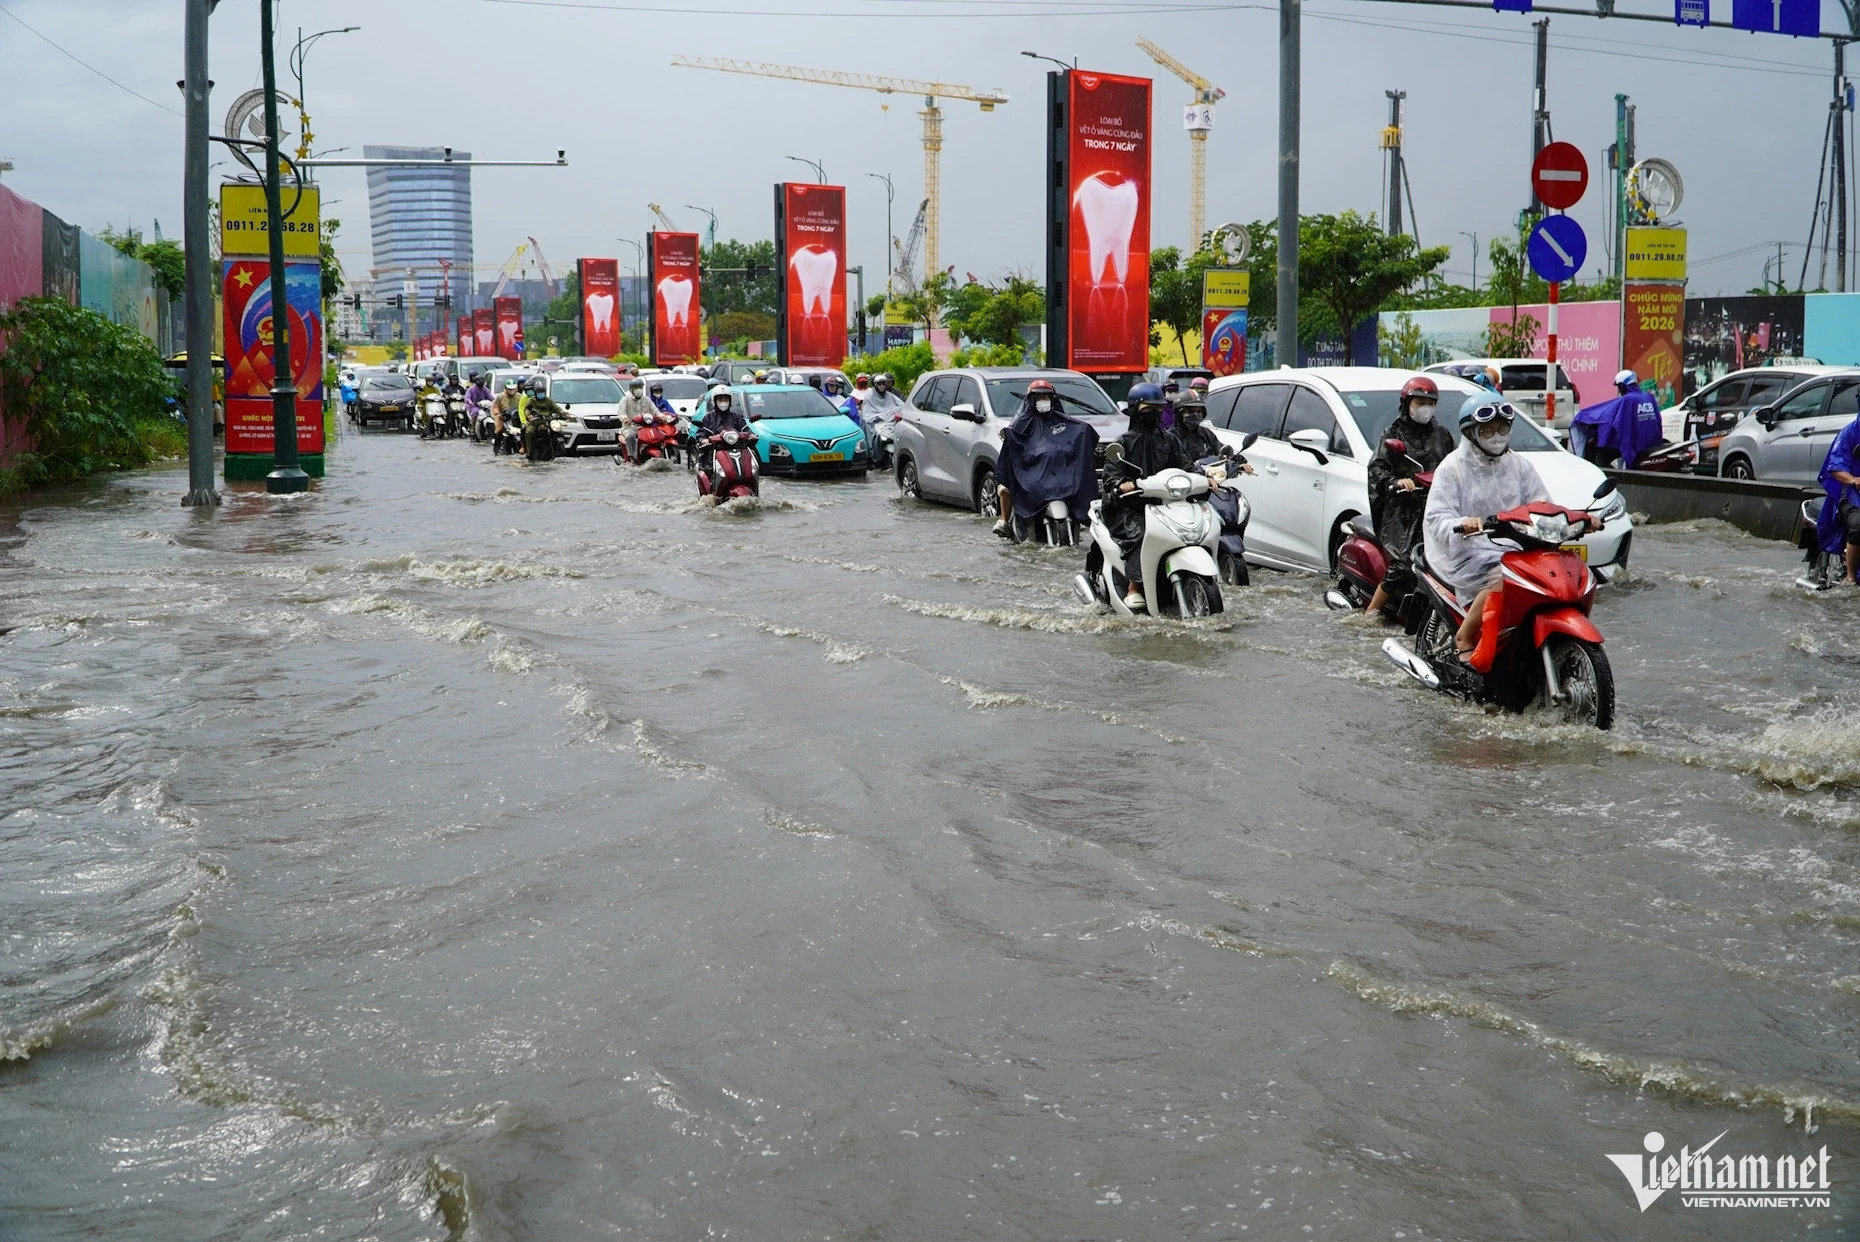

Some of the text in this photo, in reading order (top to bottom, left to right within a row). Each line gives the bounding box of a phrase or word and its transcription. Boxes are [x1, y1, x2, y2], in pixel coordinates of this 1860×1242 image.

[1084, 139, 1109, 150] TRONG
[1110, 142, 1115, 150] 7
[1629, 292, 1682, 303] CHÚC MỪNG
[1638, 304, 1677, 314] NĂM MỚI
[1640, 316, 1676, 331] 2026
[1571, 355, 1598, 372] CHÍNH
[1647, 351, 1674, 382] Tết
[1637, 402, 1654, 414] ACB
